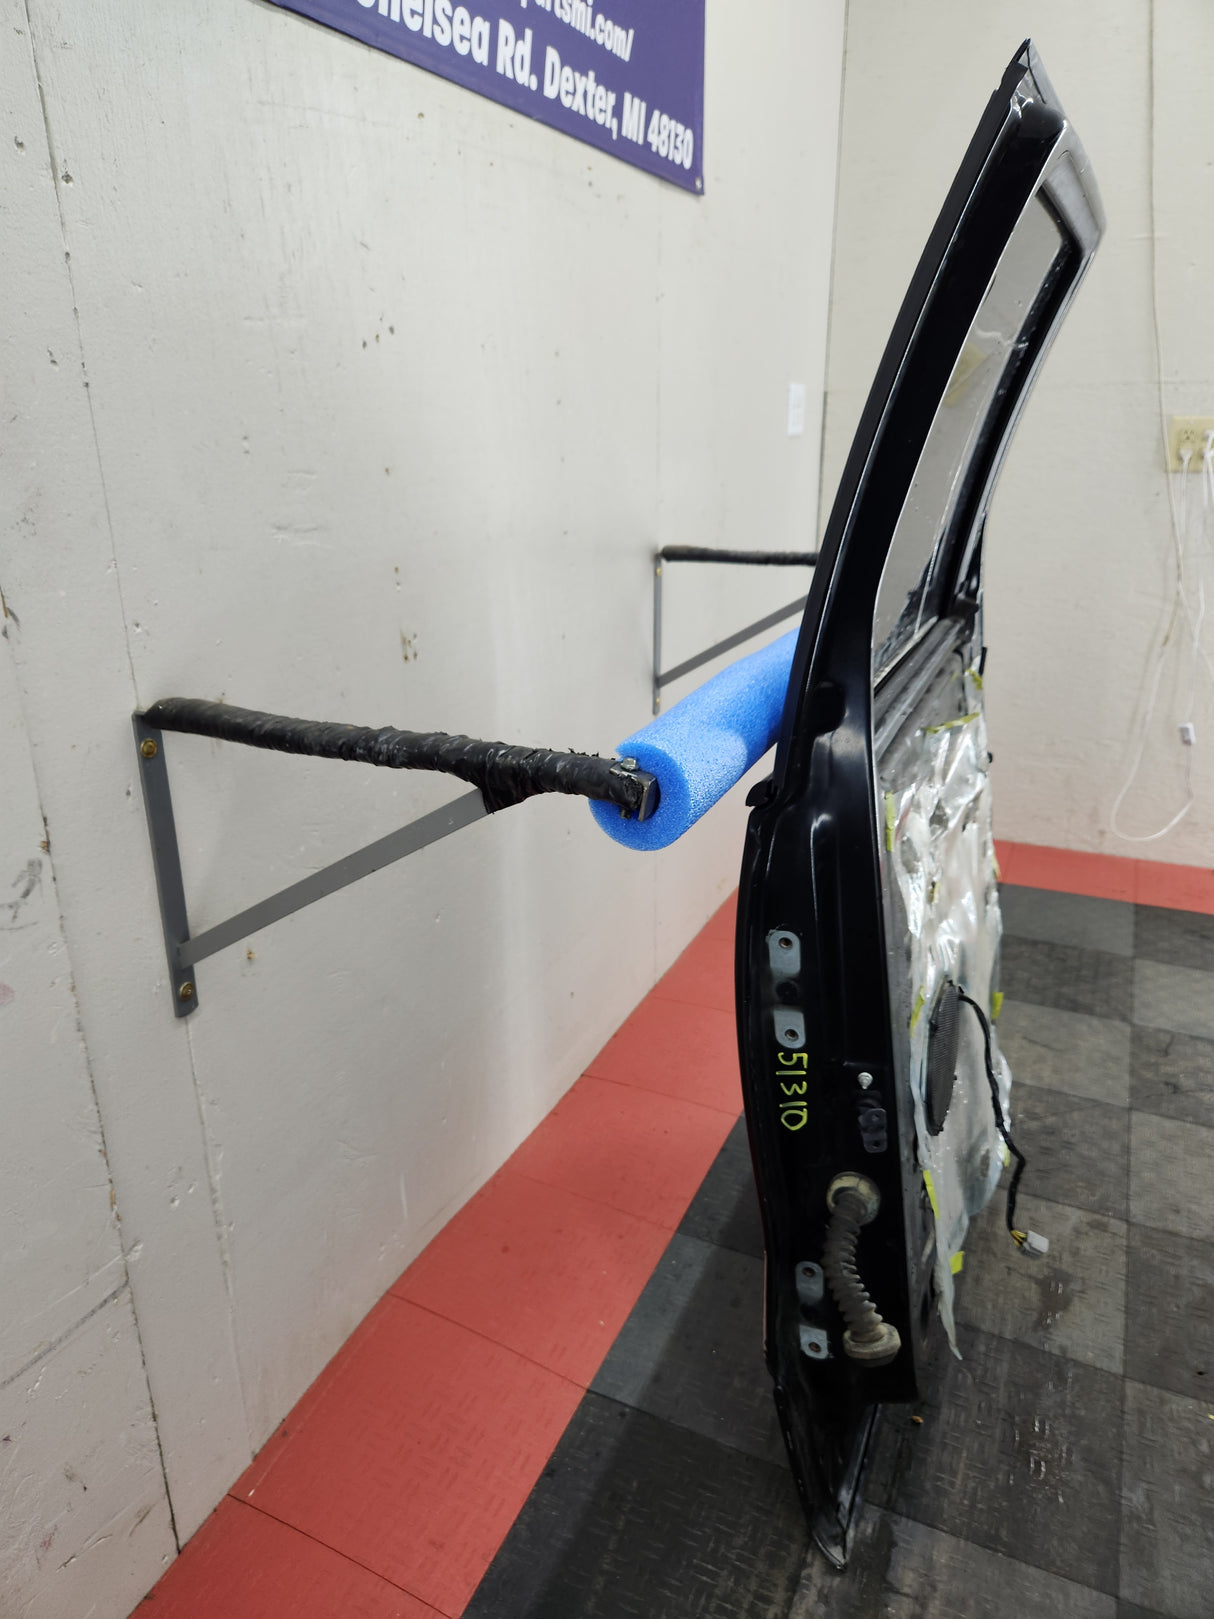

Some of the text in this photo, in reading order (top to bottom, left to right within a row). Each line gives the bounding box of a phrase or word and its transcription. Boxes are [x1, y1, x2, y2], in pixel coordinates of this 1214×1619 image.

[357, 0, 694, 170] elsea Rd. Dexter, MI 48130
[520, 0, 635, 62] smi.com/
